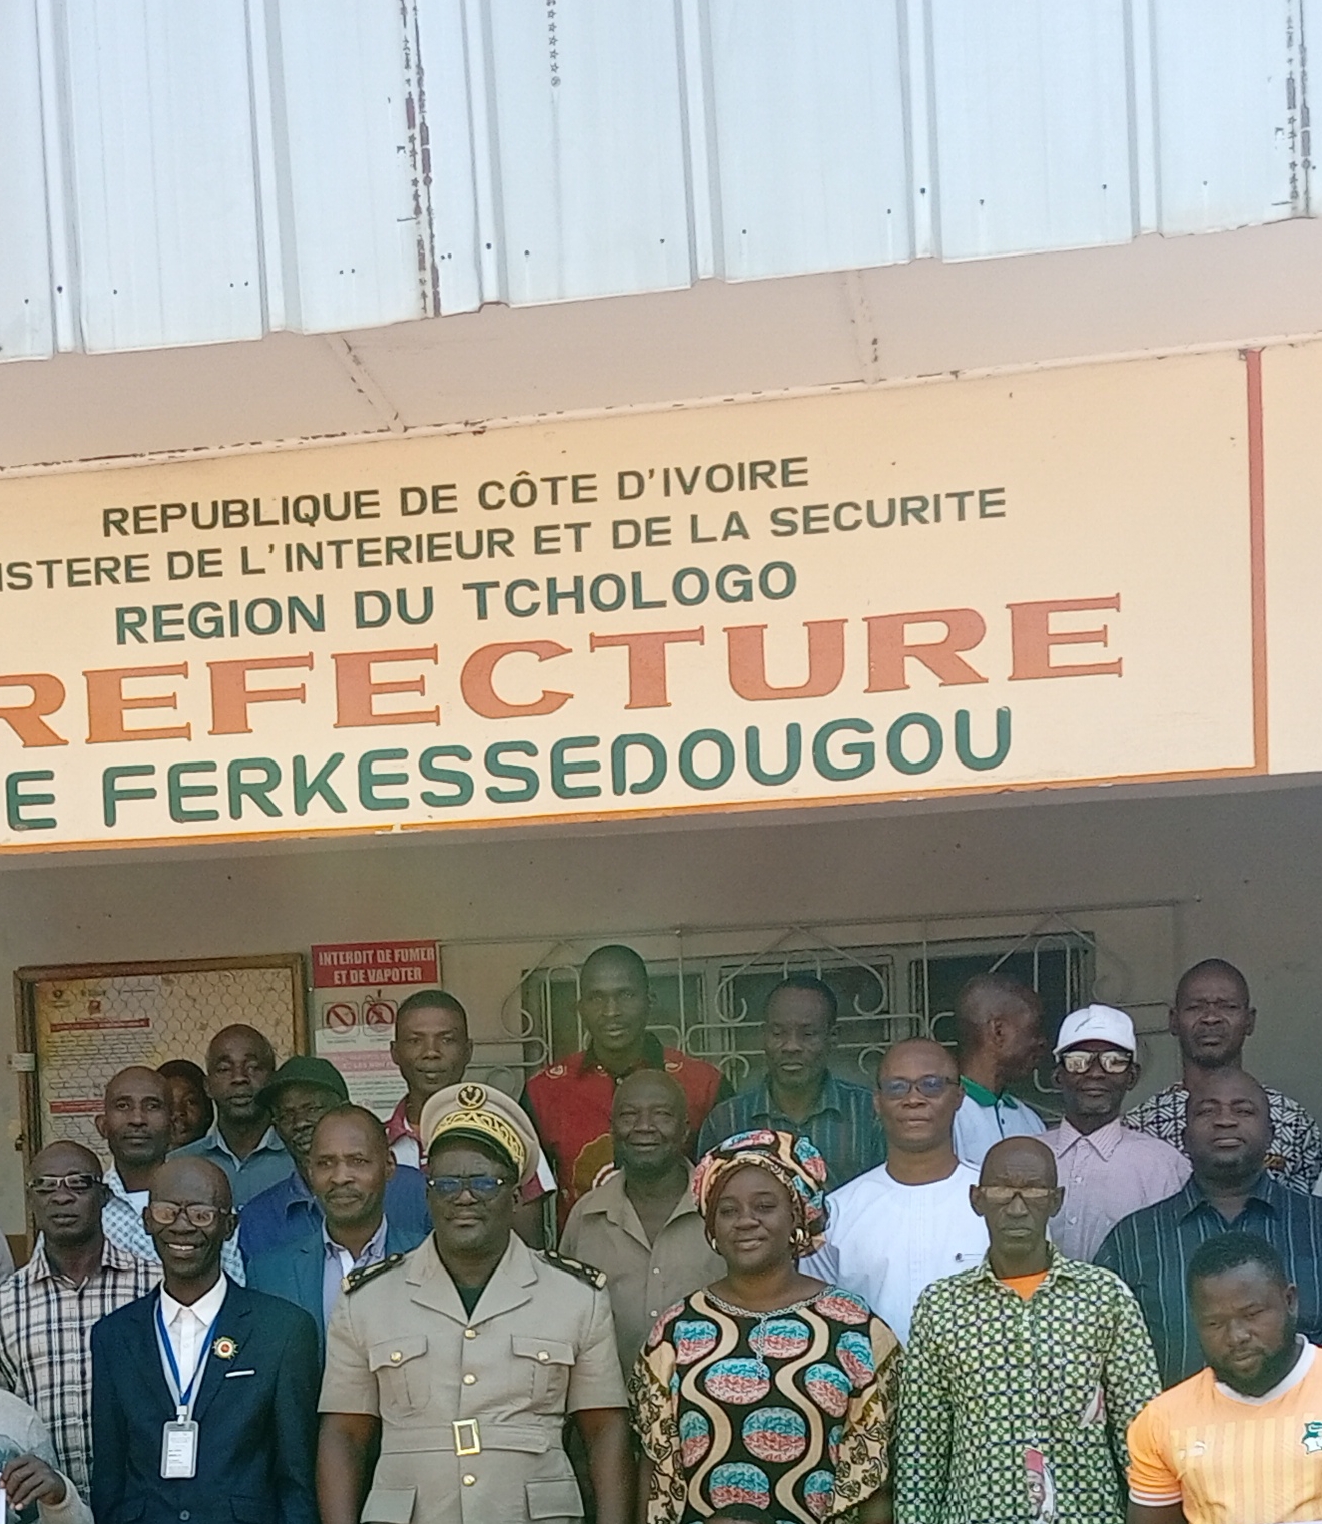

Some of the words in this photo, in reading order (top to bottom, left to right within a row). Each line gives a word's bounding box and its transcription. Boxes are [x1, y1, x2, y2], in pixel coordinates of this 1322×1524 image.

[101, 487, 382, 539] REPUBLIQUE
[398, 482, 460, 518] DE
[476, 466, 599, 512] CÔTE
[616, 455, 810, 502] D'IVOIRE
[165, 546, 225, 582] DE
[239, 526, 517, 579] L'INTERIEUR
[532, 520, 593, 557] ET
[610, 514, 673, 551] DE
[689, 509, 752, 545] LA
[768, 485, 1008, 539] SECURITE
[113, 592, 327, 647] REGION
[352, 584, 435, 631] DU
[460, 559, 798, 622] TCHOLOGO
[102, 708, 1012, 826] FERKESSEDOUGOU
[319, 950, 375, 966] INTERDIT
[377, 949, 392, 963] DE
[394, 947, 435, 962] FUMER
[334, 970, 347, 985] ET
[349, 969, 366, 983] DE
[367, 966, 422, 983] VAPOTER
